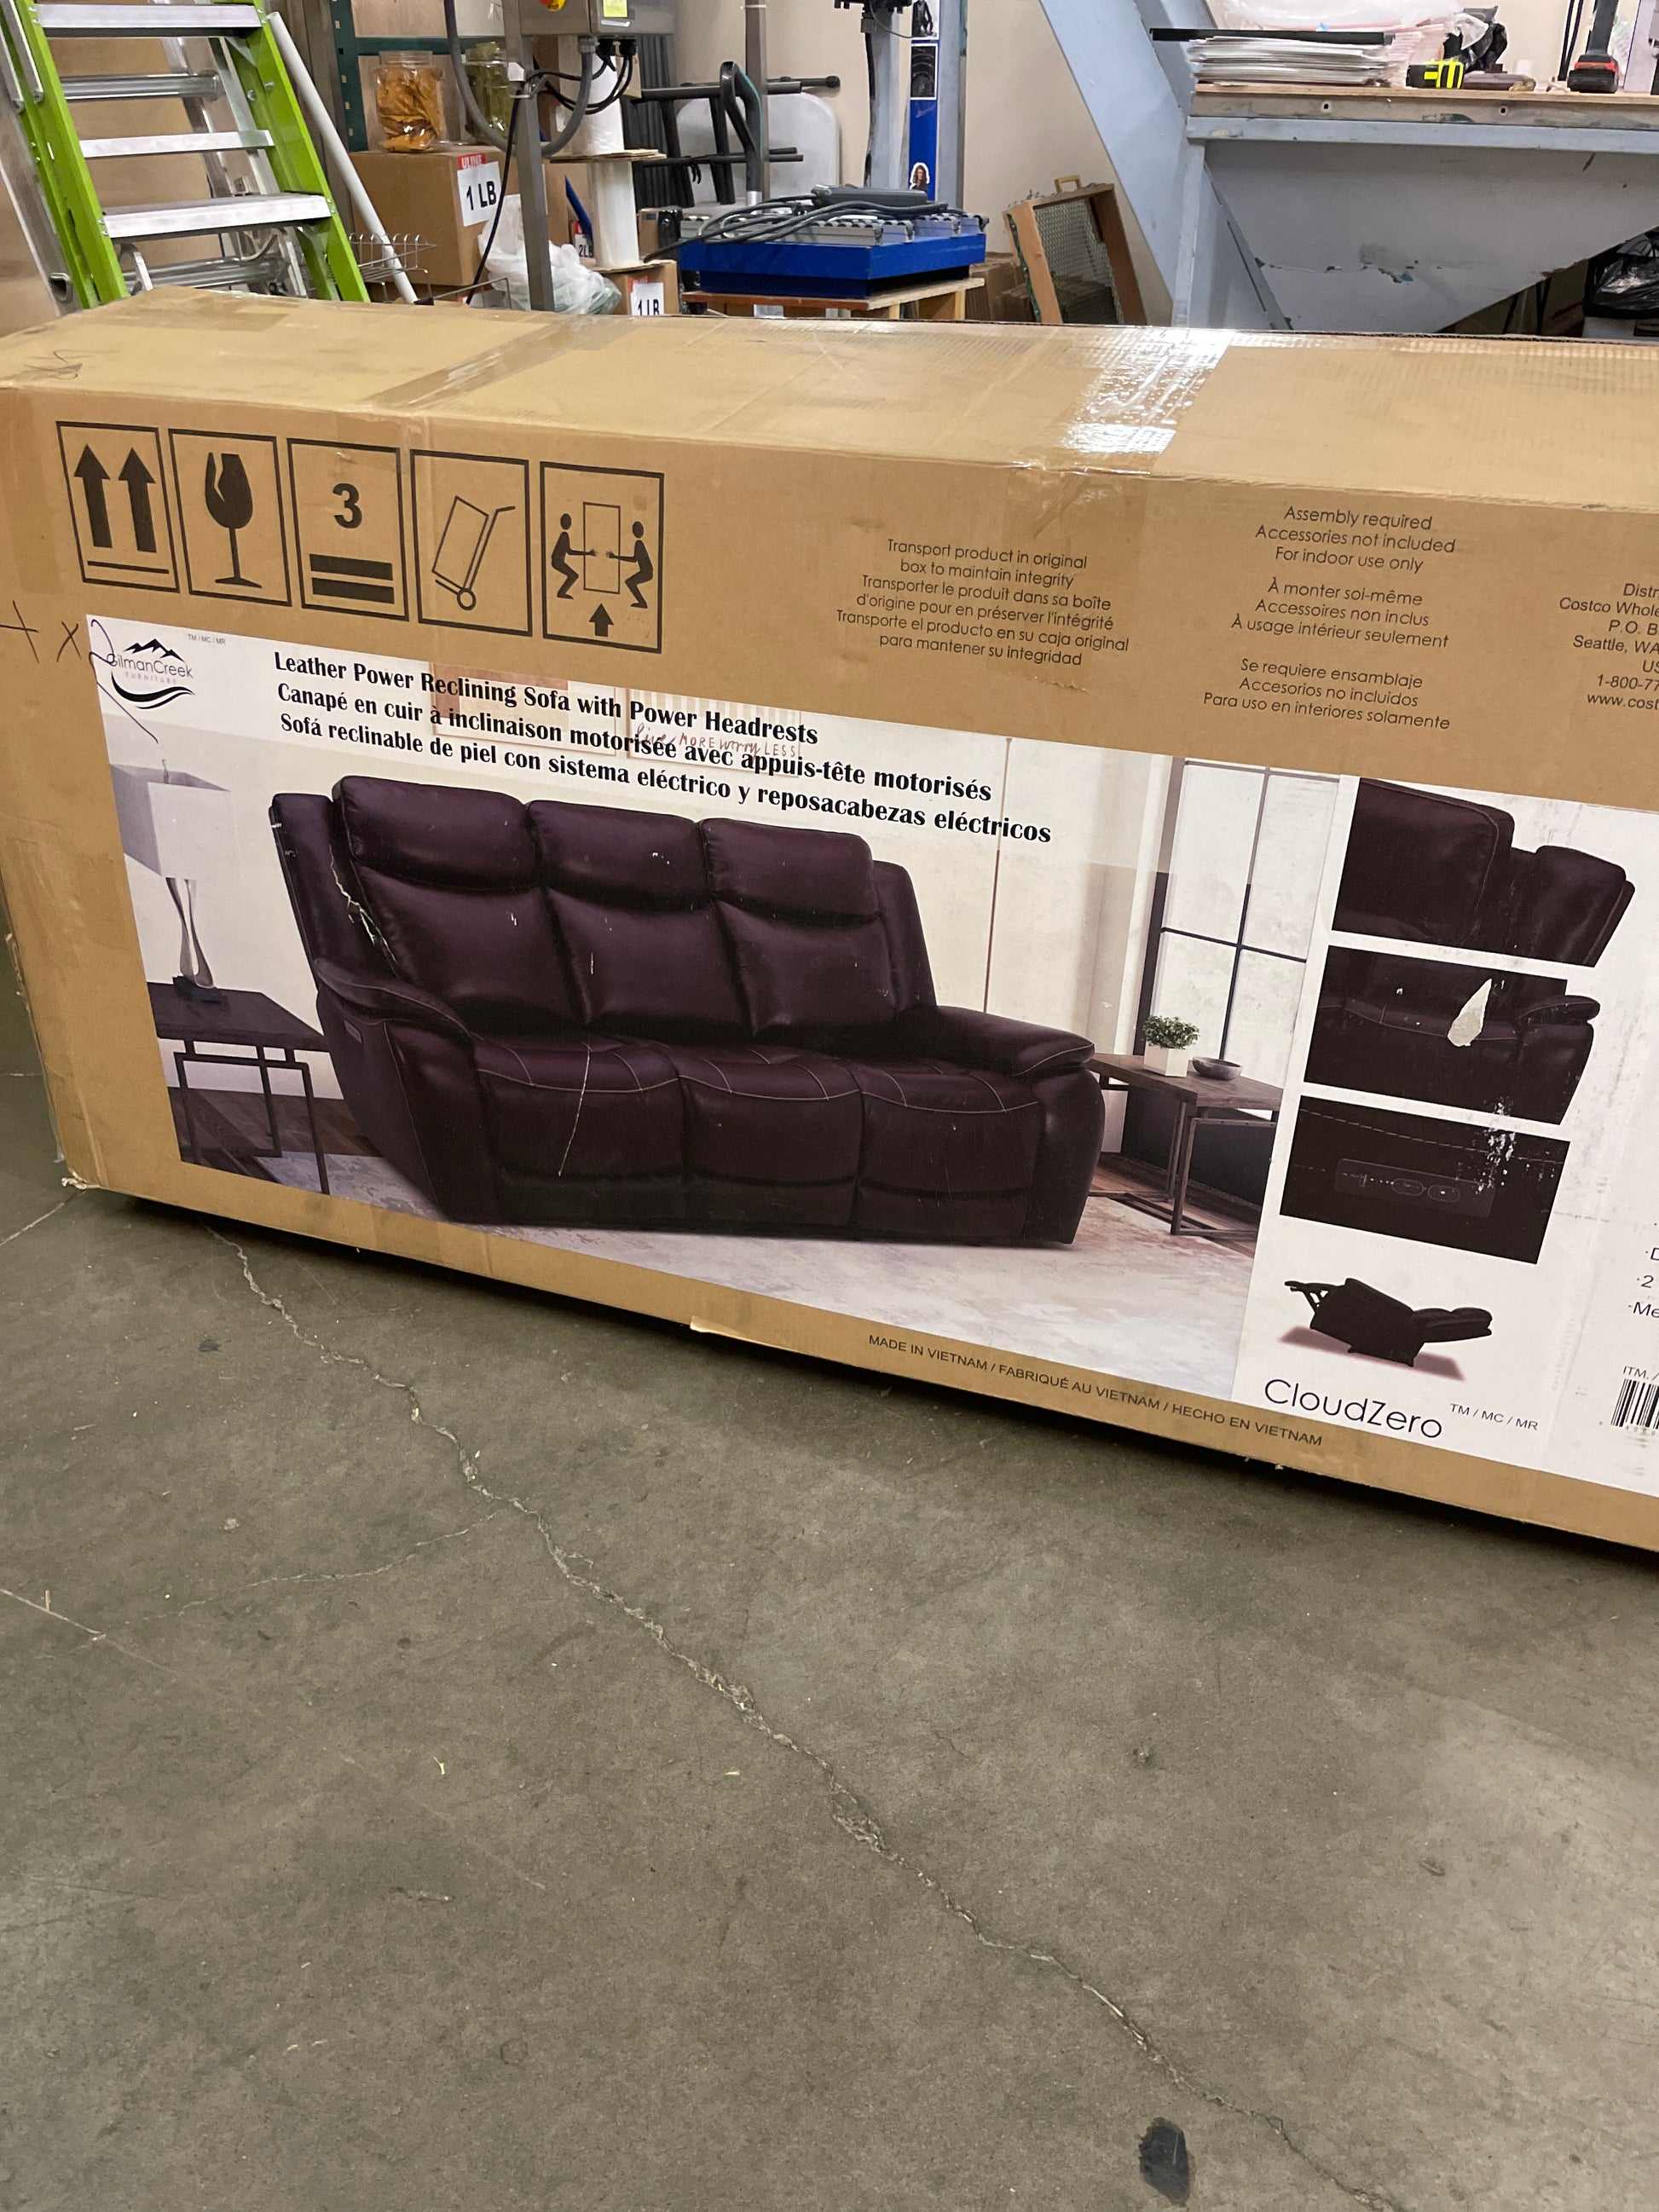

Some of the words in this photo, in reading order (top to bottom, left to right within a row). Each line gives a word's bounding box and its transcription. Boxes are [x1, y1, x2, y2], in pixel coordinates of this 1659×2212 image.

[466, 186, 474, 211] 1
[478, 181, 496, 207] LB
[333, 482, 362, 529] 3
[1284, 506, 1359, 528] Assembly
[1363, 514, 1432, 530] required
[887, 539, 951, 559] Transport
[955, 547, 1013, 563] product
[1017, 550, 1028, 563] in
[1033, 553, 1087, 569] original
[1256, 525, 1347, 545] Accessories
[1352, 534, 1379, 546] not
[1383, 534, 1456, 553] included
[901, 559, 926, 574] box
[930, 562, 944, 575] to
[949, 565, 1011, 581] maintain
[1015, 570, 1074, 589] integrity
[1275, 546, 1298, 560] For
[1303, 548, 1353, 566] indoor
[1358, 557, 1384, 569] use
[1390, 557, 1423, 574] only
[862, 575, 939, 594] Transporter
[942, 582, 954, 595] le
[958, 586, 1009, 600] produit
[1014, 590, 1049, 605] dans
[1053, 597, 1067, 607] sa
[1073, 594, 1111, 610] boîte
[1268, 577, 1279, 592] À
[1284, 582, 1340, 598] monter
[1344, 587, 1423, 606] soi-même
[1559, 598, 1610, 613] Costco
[857, 593, 915, 611] d'origine
[919, 603, 951, 616] pour
[956, 605, 973, 616] en
[978, 606, 1043, 624] préserver
[1048, 611, 1113, 631] l'intégrité
[1255, 599, 1345, 619] Accessoires
[1350, 610, 1380, 622] non
[1385, 609, 1429, 627] inclus
[1609, 620, 1640, 634] P.O.
[837, 609, 907, 629] Transporte
[911, 618, 922, 630] el
[927, 621, 992, 638] producto
[997, 628, 1014, 640] en
[1019, 630, 1033, 642] su
[1039, 632, 1070, 648] caja
[1075, 634, 1129, 652] original
[1231, 614, 1242, 628] À
[1247, 620, 1294, 635] usage
[1298, 622, 1361, 640] intérieur
[1365, 630, 1448, 648] seulement
[1573, 635, 1627, 654] Seattle,
[880, 633, 912, 649] para
[916, 638, 984, 656] mantener
[988, 645, 1003, 657] su
[1007, 645, 1082, 666] integridad
[1240, 658, 1258, 672] Se
[1263, 661, 1326, 679] requiere
[1331, 668, 1423, 690] ensamblaje
[275, 651, 346, 679] Leather
[354, 663, 414, 688] Power
[421, 672, 517, 707] Reclining
[524, 686, 570, 712] Sofa
[577, 695, 621, 718] with
[630, 701, 697, 727] Power
[705, 711, 818, 744] Headrests
[1239, 677, 1321, 697] Accesorios
[1327, 688, 1346, 699] no
[1350, 687, 1419, 707] incluidos
[1204, 692, 1238, 707] Para
[1241, 699, 1267, 711] uso
[1272, 702, 1291, 713] en
[1295, 701, 1363, 720] interiores
[1367, 709, 1450, 730] solamente
[278, 683, 348, 712] Canapé
[355, 697, 377, 714] en
[384, 702, 423, 720] cuir
[430, 705, 442, 725] à
[449, 707, 562, 742] inclinaison
[570, 729, 677, 758] motorisée
[685, 744, 733, 766] avec
[741, 752, 865, 784] appuis-tête
[874, 771, 991, 800] motorisés
[280, 713, 322, 736] Sofá
[328, 724, 423, 752] reclinable
[430, 736, 454, 757] de
[460, 742, 496, 763] piel
[504, 750, 540, 770] con
[548, 755, 630, 783] sistema
[638, 767, 731, 798] eléctrico
[738, 785, 751, 805] y
[757, 788, 926, 826] reposacabezas
[934, 810, 1051, 843] eléctricos
[1623, 1366, 1649, 1379] ITM.
[869, 1335, 906, 1352] MADE
[910, 1344, 923, 1355] IN
[928, 1348, 987, 1371] VIETNAM
[991, 1363, 997, 1372] /
[999, 1365, 1069, 1389] FABRIQUÉ
[1072, 1382, 1091, 1394] AU
[1096, 1386, 1159, 1410] VIETNAM
[1163, 1402, 1169, 1411] /
[1172, 1403, 1225, 1424] HECHO
[1230, 1417, 1251, 1429] EN
[1255, 1422, 1322, 1446] VIETNAM
[1265, 1379, 1442, 1438] CloudZero
[1450, 1403, 1471, 1416] TM
[1473, 1408, 1478, 1418] /
[1482, 1411, 1504, 1423] MC
[1507, 1416, 1513, 1424] /
[1516, 1418, 1538, 1430] MR
